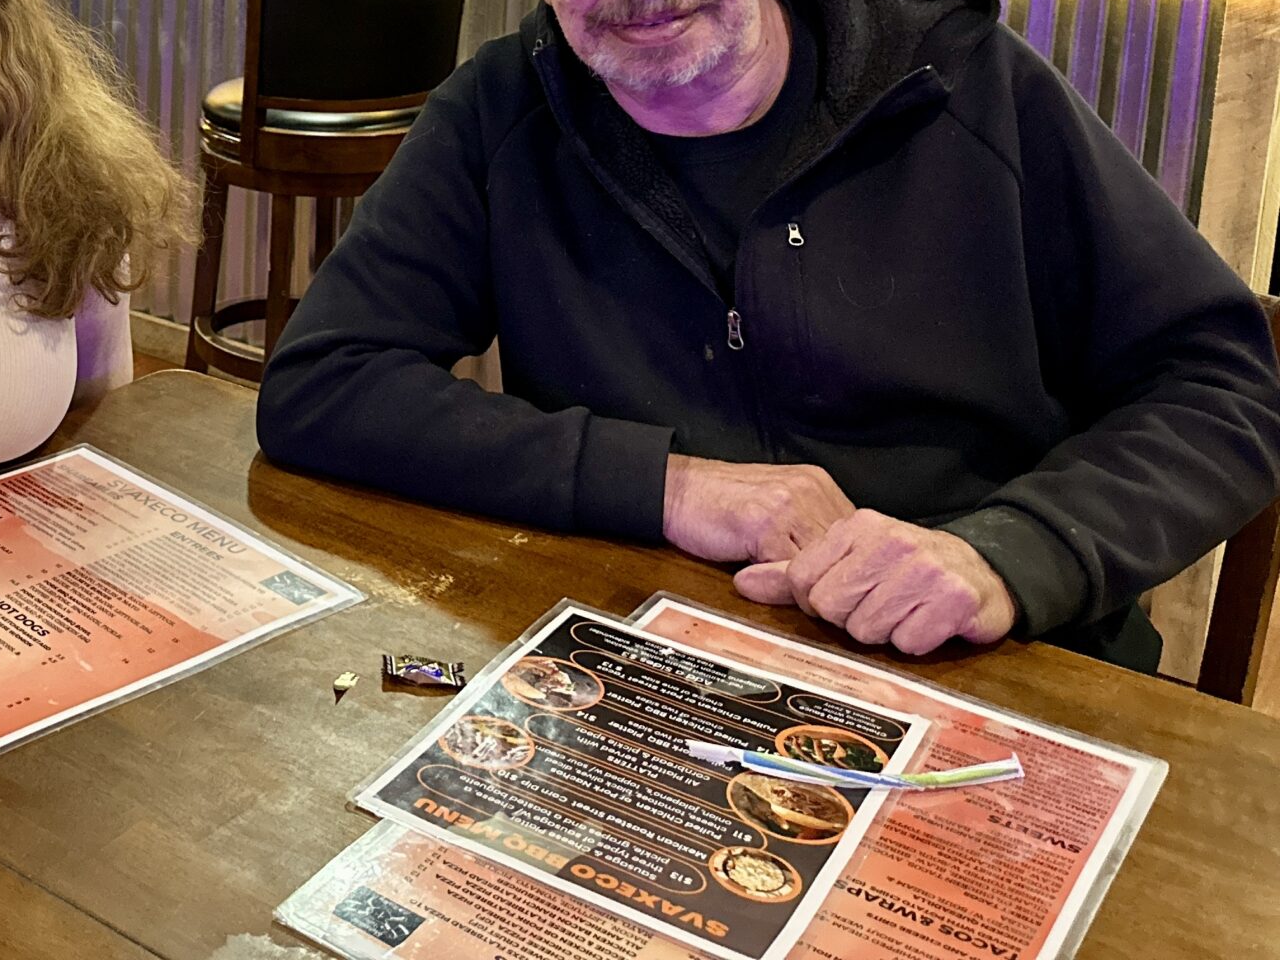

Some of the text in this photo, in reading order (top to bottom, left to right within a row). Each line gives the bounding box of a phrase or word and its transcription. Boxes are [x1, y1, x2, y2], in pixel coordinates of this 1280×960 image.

[103, 479, 249, 555] SVAXECO MENU
[168, 531, 224, 560] ENTREES
[12, 613, 51, 636] DOGS
[594, 664, 628, 678] Tacos
[637, 657, 674, 672] Sides
[627, 676, 659, 689] Street
[686, 674, 714, 686] Add
[658, 687, 684, 699] Pork
[575, 710, 597, 721] $14
[604, 691, 750, 746] Pulled Chicken BBQ Platter
[696, 701, 742, 720] Chicken
[573, 726, 607, 741] spear
[606, 720, 645, 737] Platter
[742, 717, 778, 732] Pulled
[605, 738, 640, 754] pickle
[646, 734, 671, 747] BBQ
[543, 756, 573, 771] diced
[574, 735, 701, 787] All Platters served with
[605, 754, 659, 778] PLATTERS
[650, 755, 711, 781] cornbread
[457, 773, 510, 798] baguette
[603, 780, 633, 795] black
[508, 795, 553, 816] toasted
[547, 767, 723, 839] Pulled Chicken or Pork Nachos
[495, 768, 708, 859] Mexican Roasted Street Corn Dip $10
[561, 816, 588, 830] and
[531, 813, 583, 839] sausage
[732, 829, 753, 841] $11
[986, 813, 1082, 854] SWEETS
[581, 835, 596, 845] of
[587, 826, 632, 848] grapes
[507, 815, 694, 885] $13 Sausage & Cheese Platter
[595, 840, 631, 859] types
[410, 796, 730, 937] SVAXECO BBQ MENU
[629, 854, 665, 873] three
